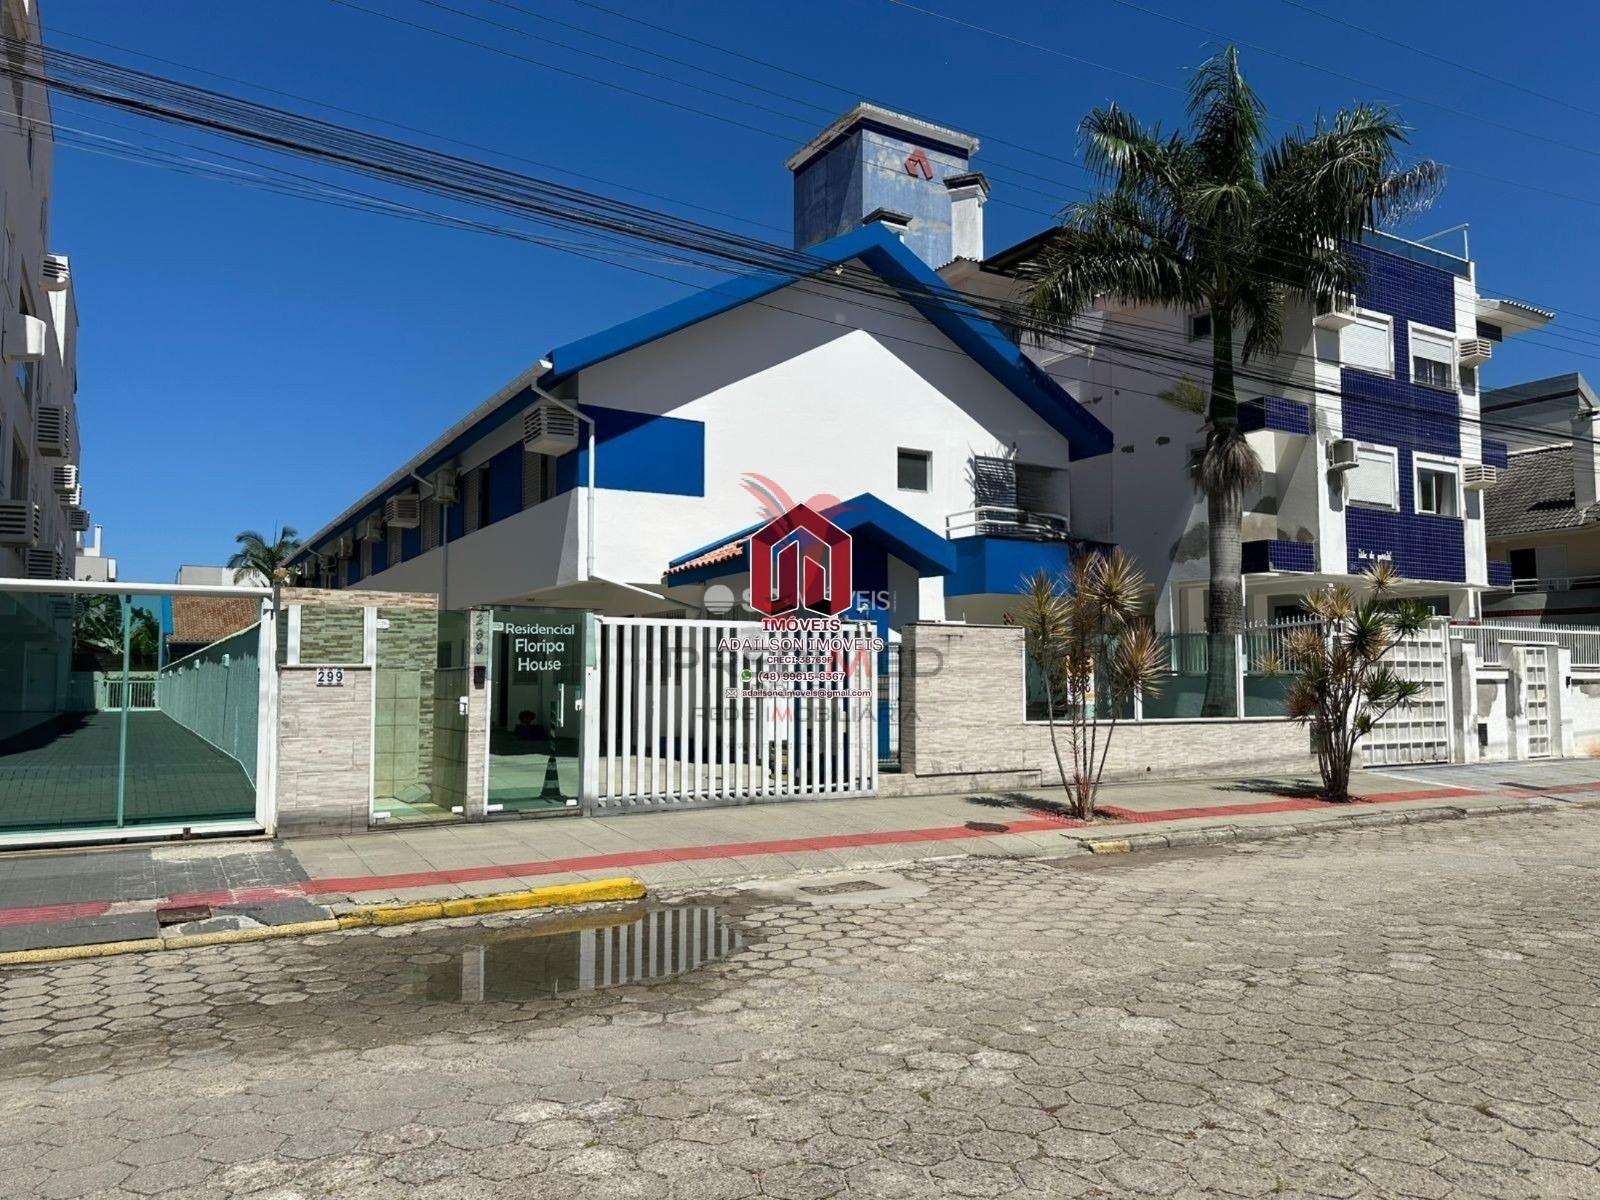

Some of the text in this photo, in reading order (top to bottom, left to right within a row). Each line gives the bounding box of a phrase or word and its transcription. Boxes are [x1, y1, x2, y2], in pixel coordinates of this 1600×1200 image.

[505, 623, 575, 635] Residencial
[515, 639, 564, 655] Floripa
[518, 657, 561, 671] House
[318, 671, 343, 682] 299
